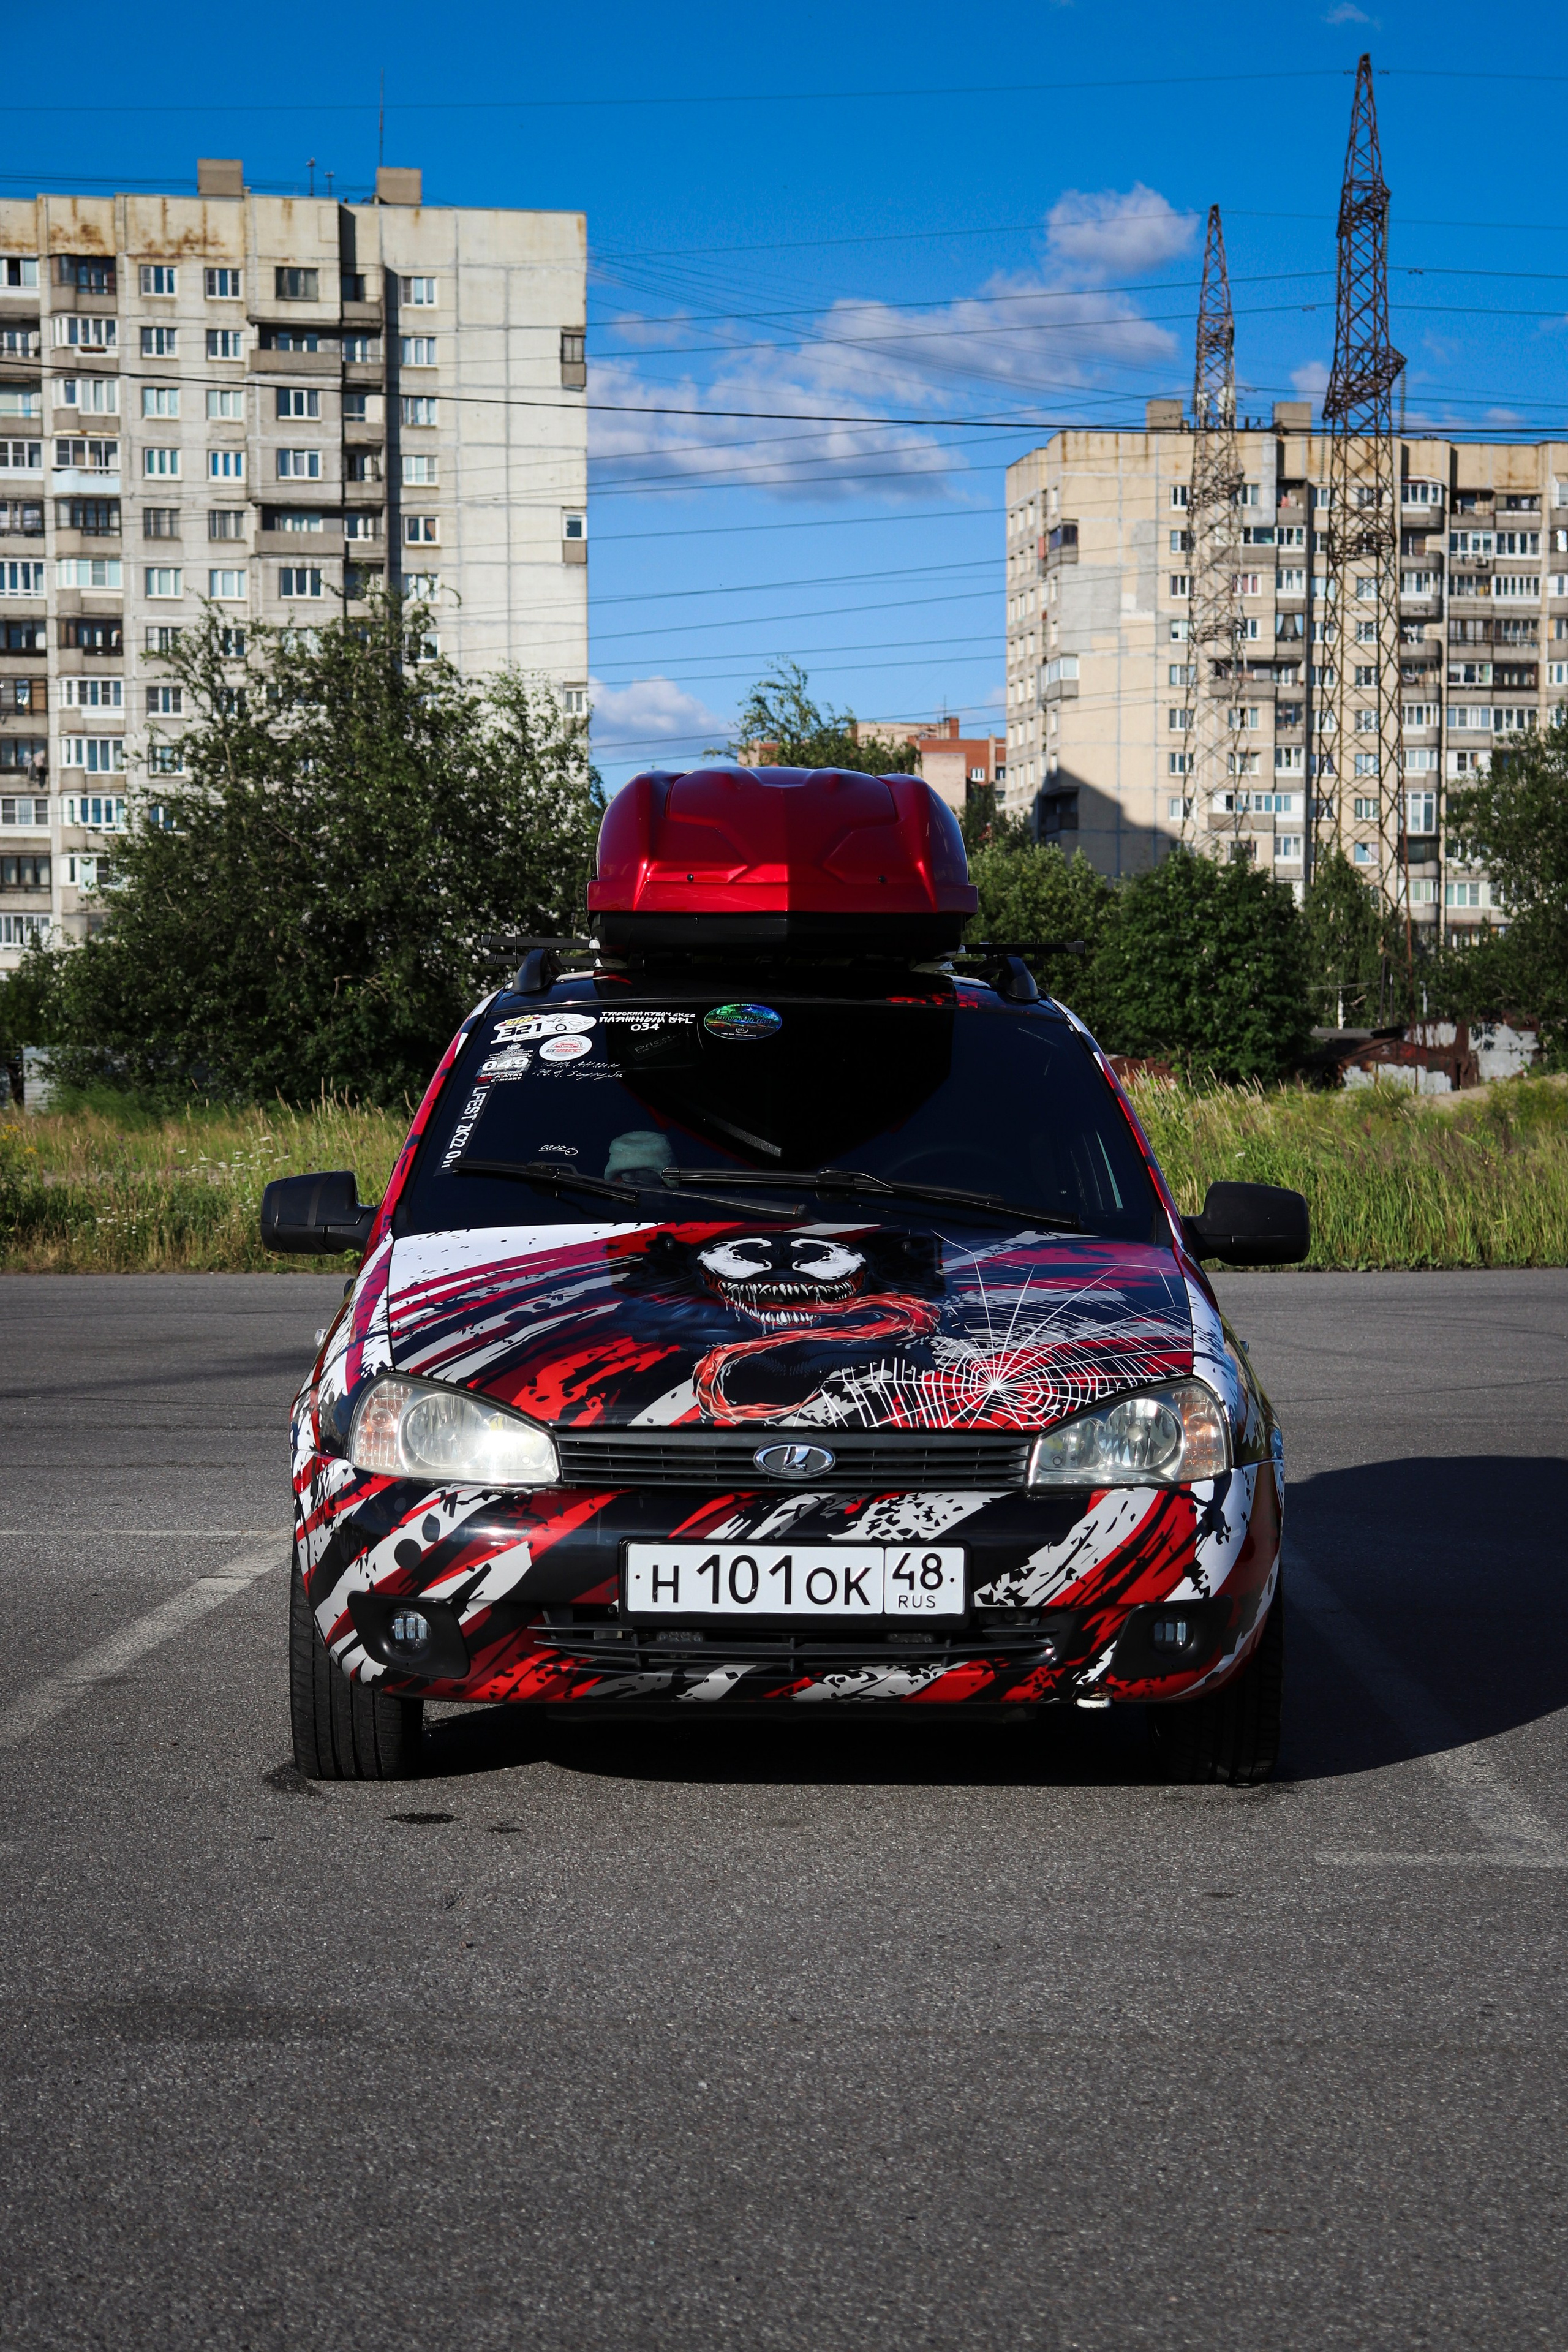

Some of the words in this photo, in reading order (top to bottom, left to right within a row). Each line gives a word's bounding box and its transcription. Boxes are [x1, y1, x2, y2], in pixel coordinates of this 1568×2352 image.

[501, 1022, 543, 1038] 321
[630, 1022, 660, 1031] 034
[481, 1057, 529, 1071] 049
[892, 1552, 943, 1591] 48
[898, 1594, 936, 1608] RUS
